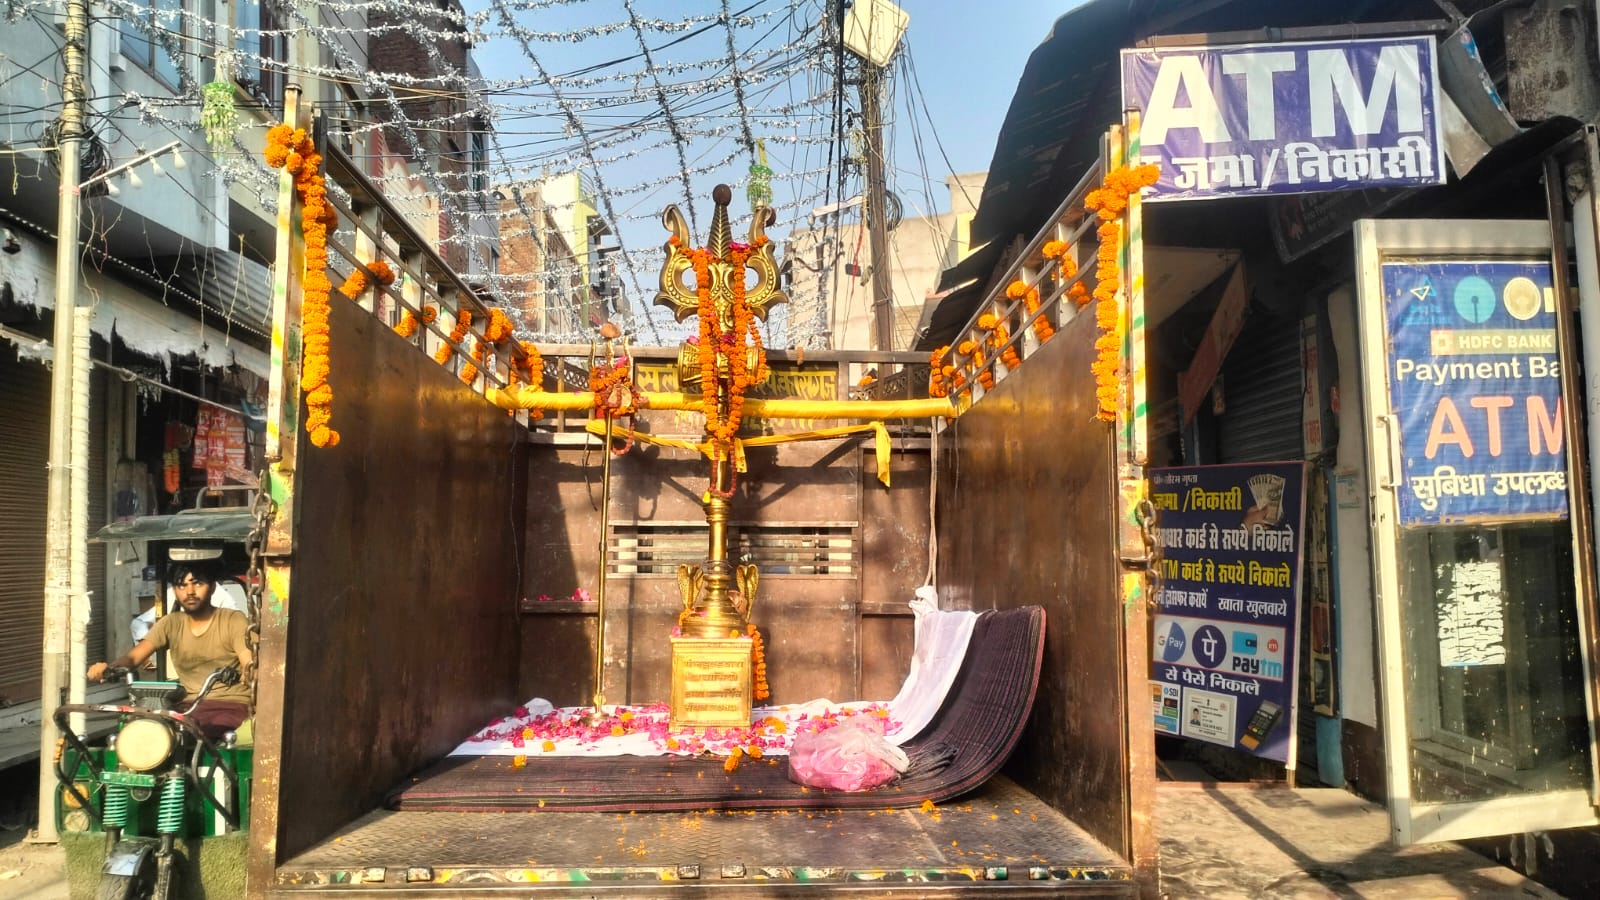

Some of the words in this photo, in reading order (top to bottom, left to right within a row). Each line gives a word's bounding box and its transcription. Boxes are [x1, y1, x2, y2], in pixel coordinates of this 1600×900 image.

[1141, 45, 1424, 146] ATM
[1459, 335, 1502, 349] HDFC
[1507, 334, 1552, 349] BANK
[1396, 357, 1523, 385] Payment
[1528, 356, 1560, 378] Ba
[1424, 395, 1564, 460] ATM
[1185, 522, 1207, 549] कार्ड
[1209, 523, 1219, 550] से
[1252, 523, 1294, 553] निकाले
[1156, 559, 1178, 579] ATM
[1181, 557, 1203, 582] कार्ड
[1205, 558, 1215, 583] से
[1249, 560, 1291, 588] निकाले
[1218, 597, 1244, 612] खाता
[1246, 599, 1287, 618] खुलवाये
[1168, 638, 1184, 650] Pay
[1201, 629, 1218, 663] पे
[1165, 665, 1178, 681] से
[1182, 667, 1206, 686] पैसे
[1209, 672, 1260, 696] निकाले
[1168, 687, 1179, 697] SBI
